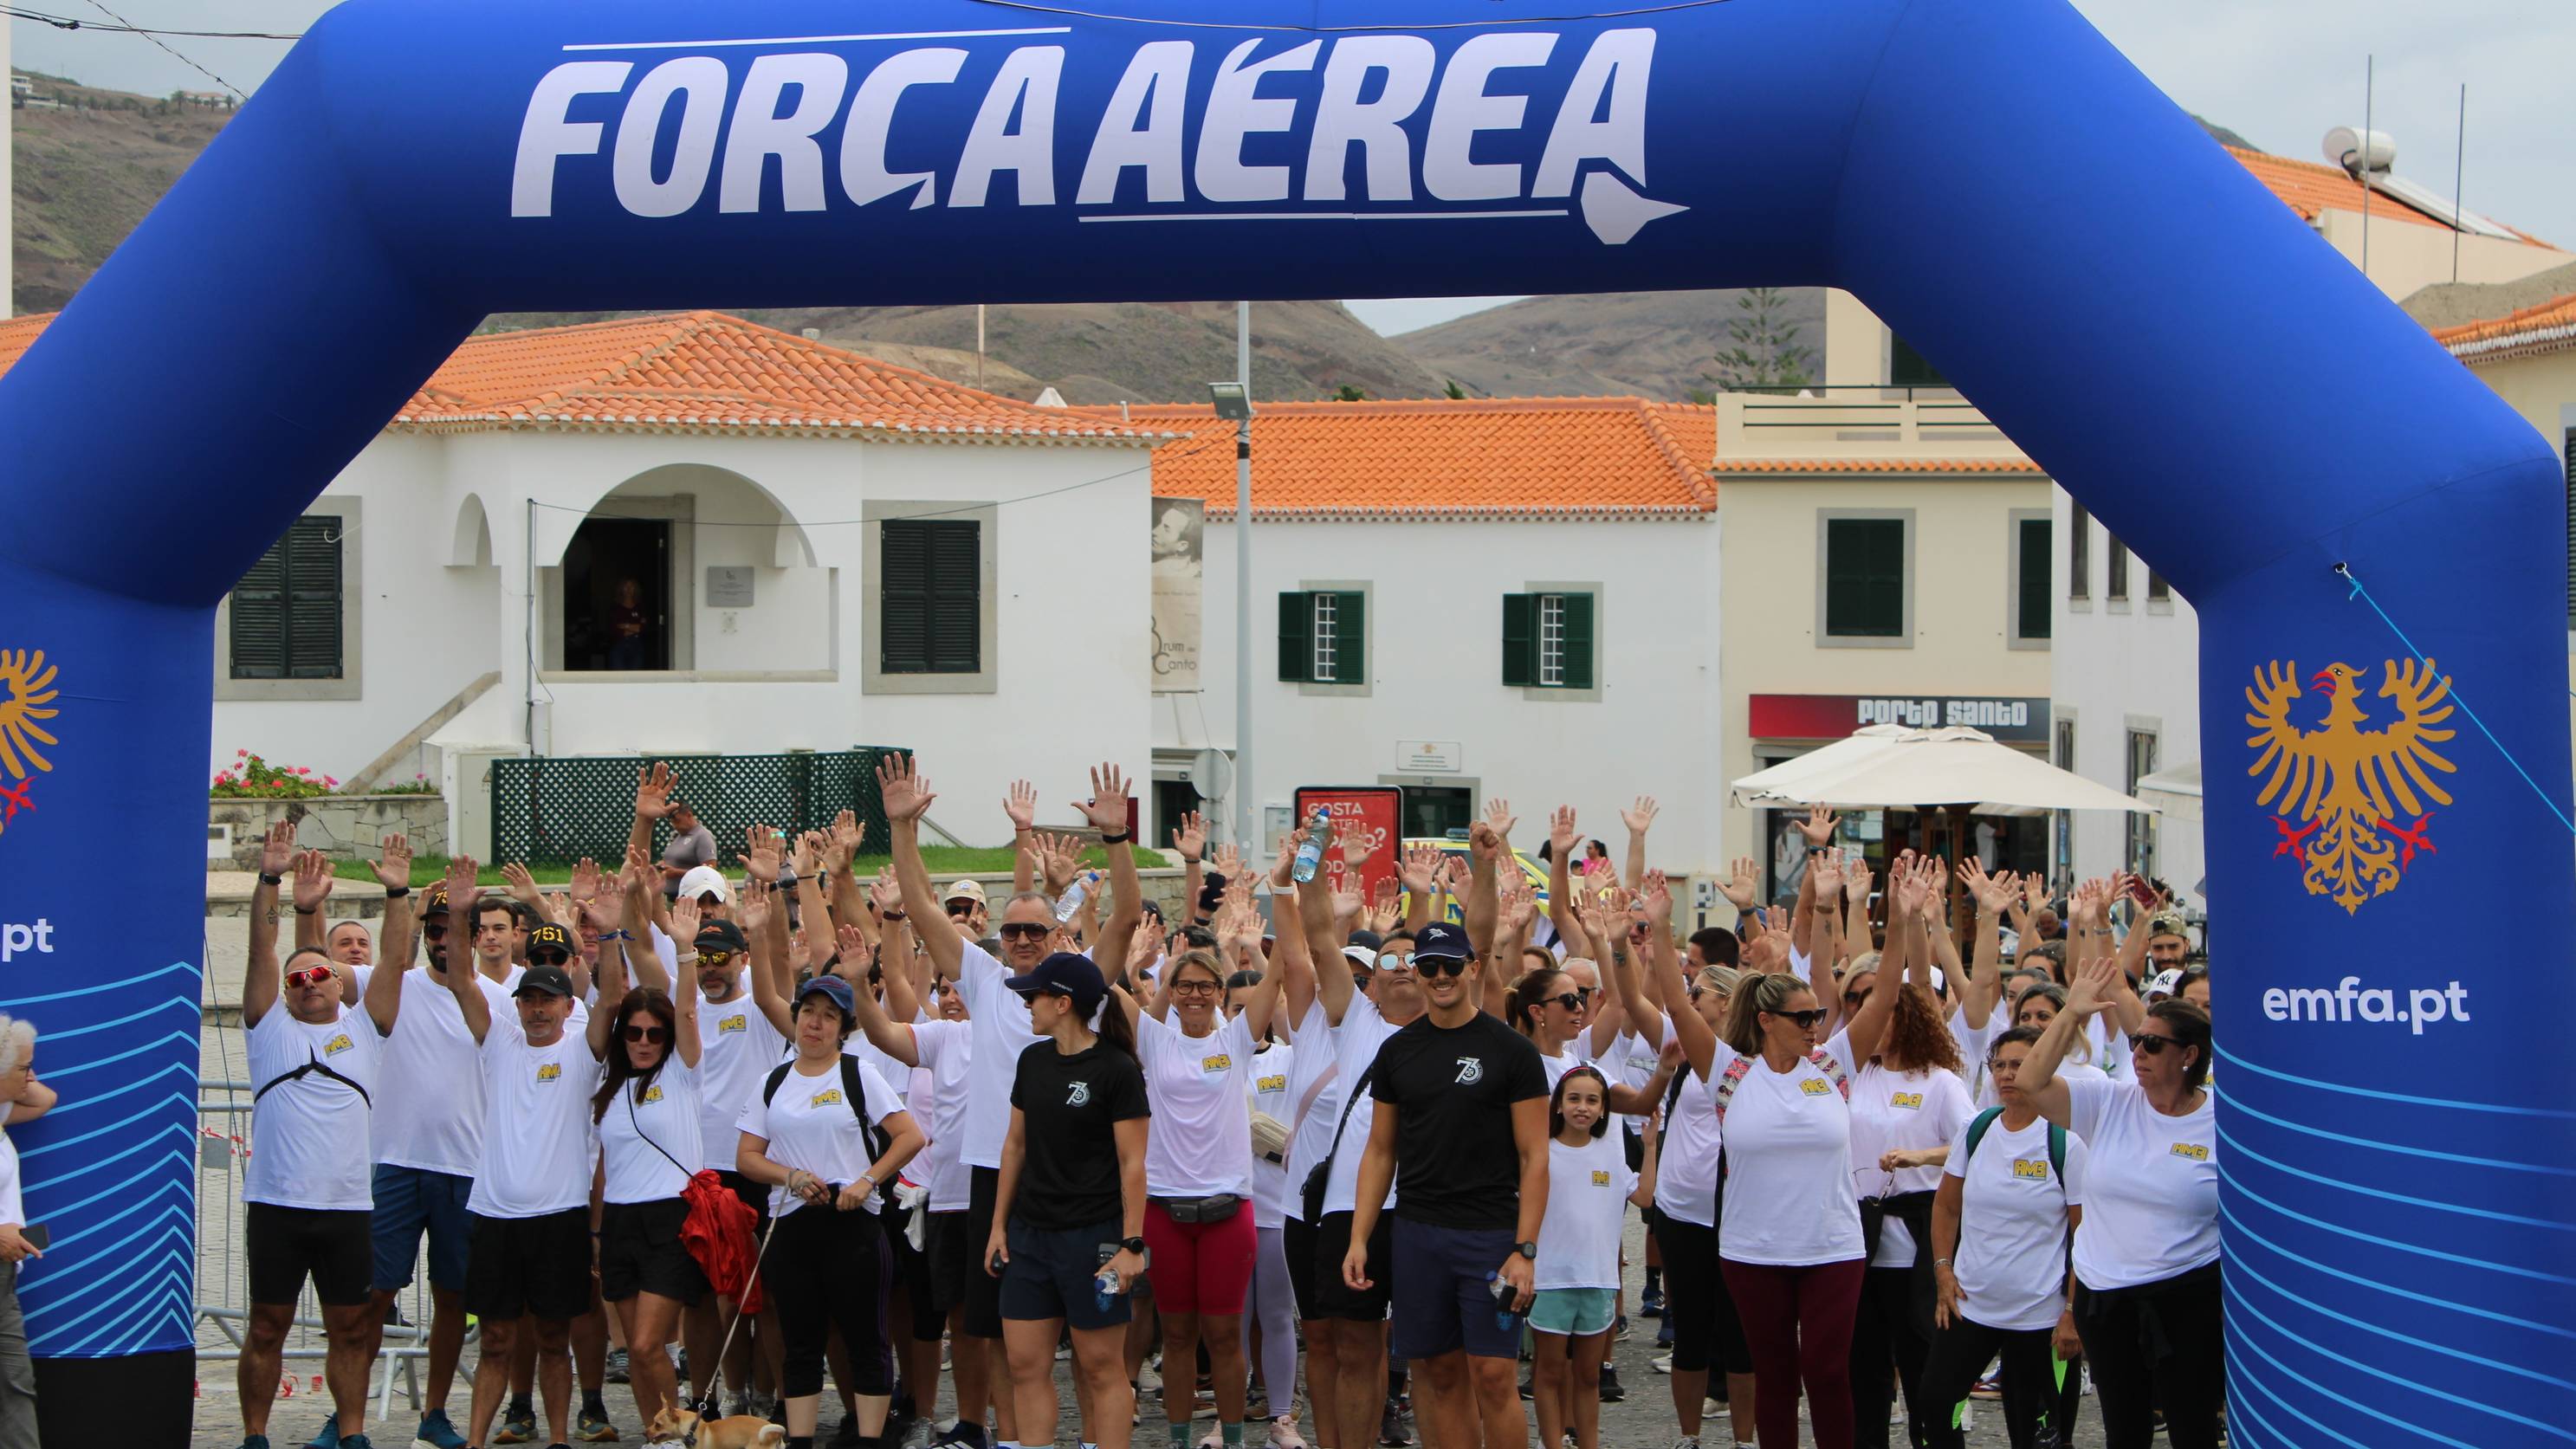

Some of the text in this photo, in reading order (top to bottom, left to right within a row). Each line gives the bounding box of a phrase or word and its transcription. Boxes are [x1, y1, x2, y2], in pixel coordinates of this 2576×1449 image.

[1152, 652, 1197, 675] Canto
[1307, 802, 1364, 816] GOSTA
[3, 918, 54, 962] pt
[532, 927, 564, 945] 751
[2262, 976, 2470, 1035] emfa.pt
